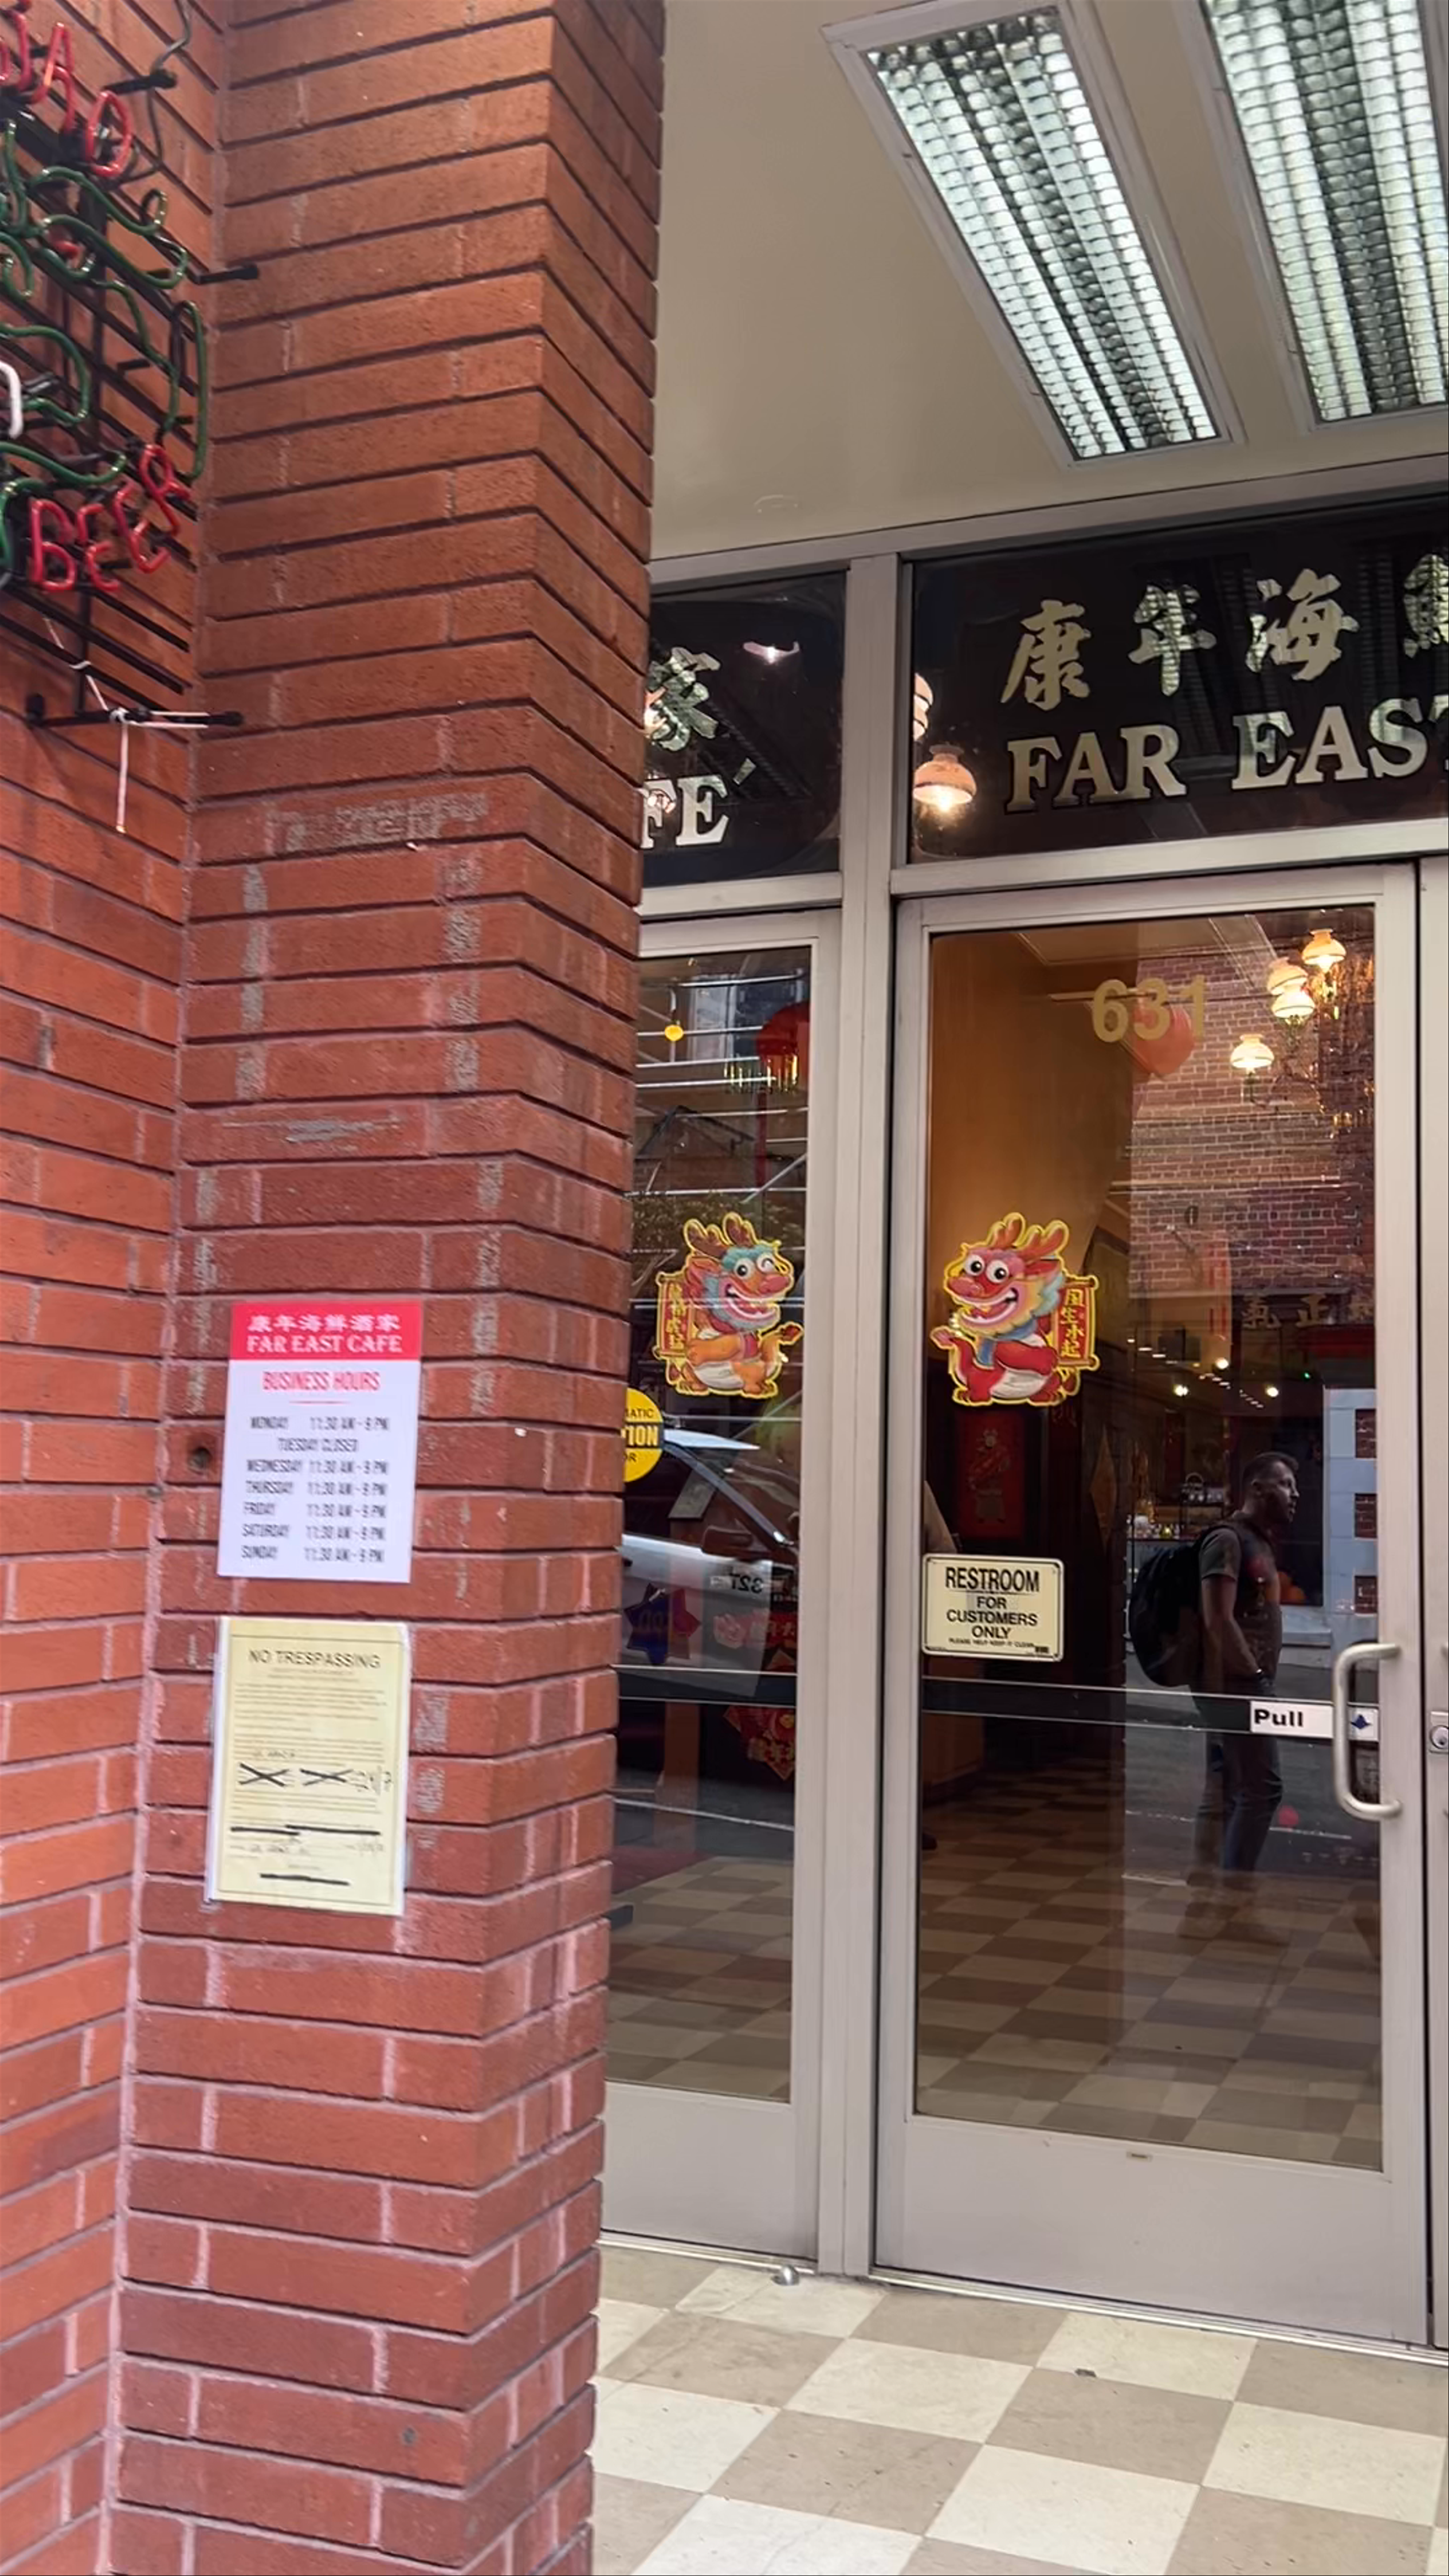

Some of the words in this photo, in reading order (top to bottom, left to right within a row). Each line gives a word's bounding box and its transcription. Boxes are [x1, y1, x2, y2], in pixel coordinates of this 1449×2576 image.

[0, 0, 132, 178] TAO
[29, 444, 191, 592] BEER
[1006, 724, 1187, 813] FAR
[1091, 974, 1206, 1043] 631
[247, 1335, 288, 1353] FAR
[292, 1335, 344, 1353] EAST
[346, 1335, 403, 1353] CAFE
[263, 1371, 330, 1390] BUSINESS
[333, 1371, 380, 1390] HOURS
[250, 1416, 288, 1429] MONDAY
[374, 1416, 389, 1430] PM
[625, 1425, 658, 1446] ION
[278, 1438, 318, 1451] TUESDAY
[321, 1438, 358, 1452] CLOSED
[246, 1459, 302, 1472] WEDNESDAY
[373, 1460, 389, 1474] PM
[245, 1480, 294, 1494] THURSDAY
[372, 1482, 388, 1496] PM
[243, 1502, 275, 1515] FRIDAY
[372, 1504, 386, 1518] PM
[242, 1523, 289, 1537] SATURDAY
[371, 1526, 385, 1540] PM
[242, 1545, 277, 1559] SUNDAY
[369, 1548, 385, 1562] PM
[946, 1567, 1040, 1592] RESTROOM
[977, 1596, 1007, 1609] FOR
[946, 1609, 1038, 1626] CUSTOMERS
[972, 1625, 1012, 1639] ONLY
[249, 1650, 271, 1663] NO
[275, 1650, 381, 1668] TRESPASSING
[1254, 1709, 1304, 1727] Pull
